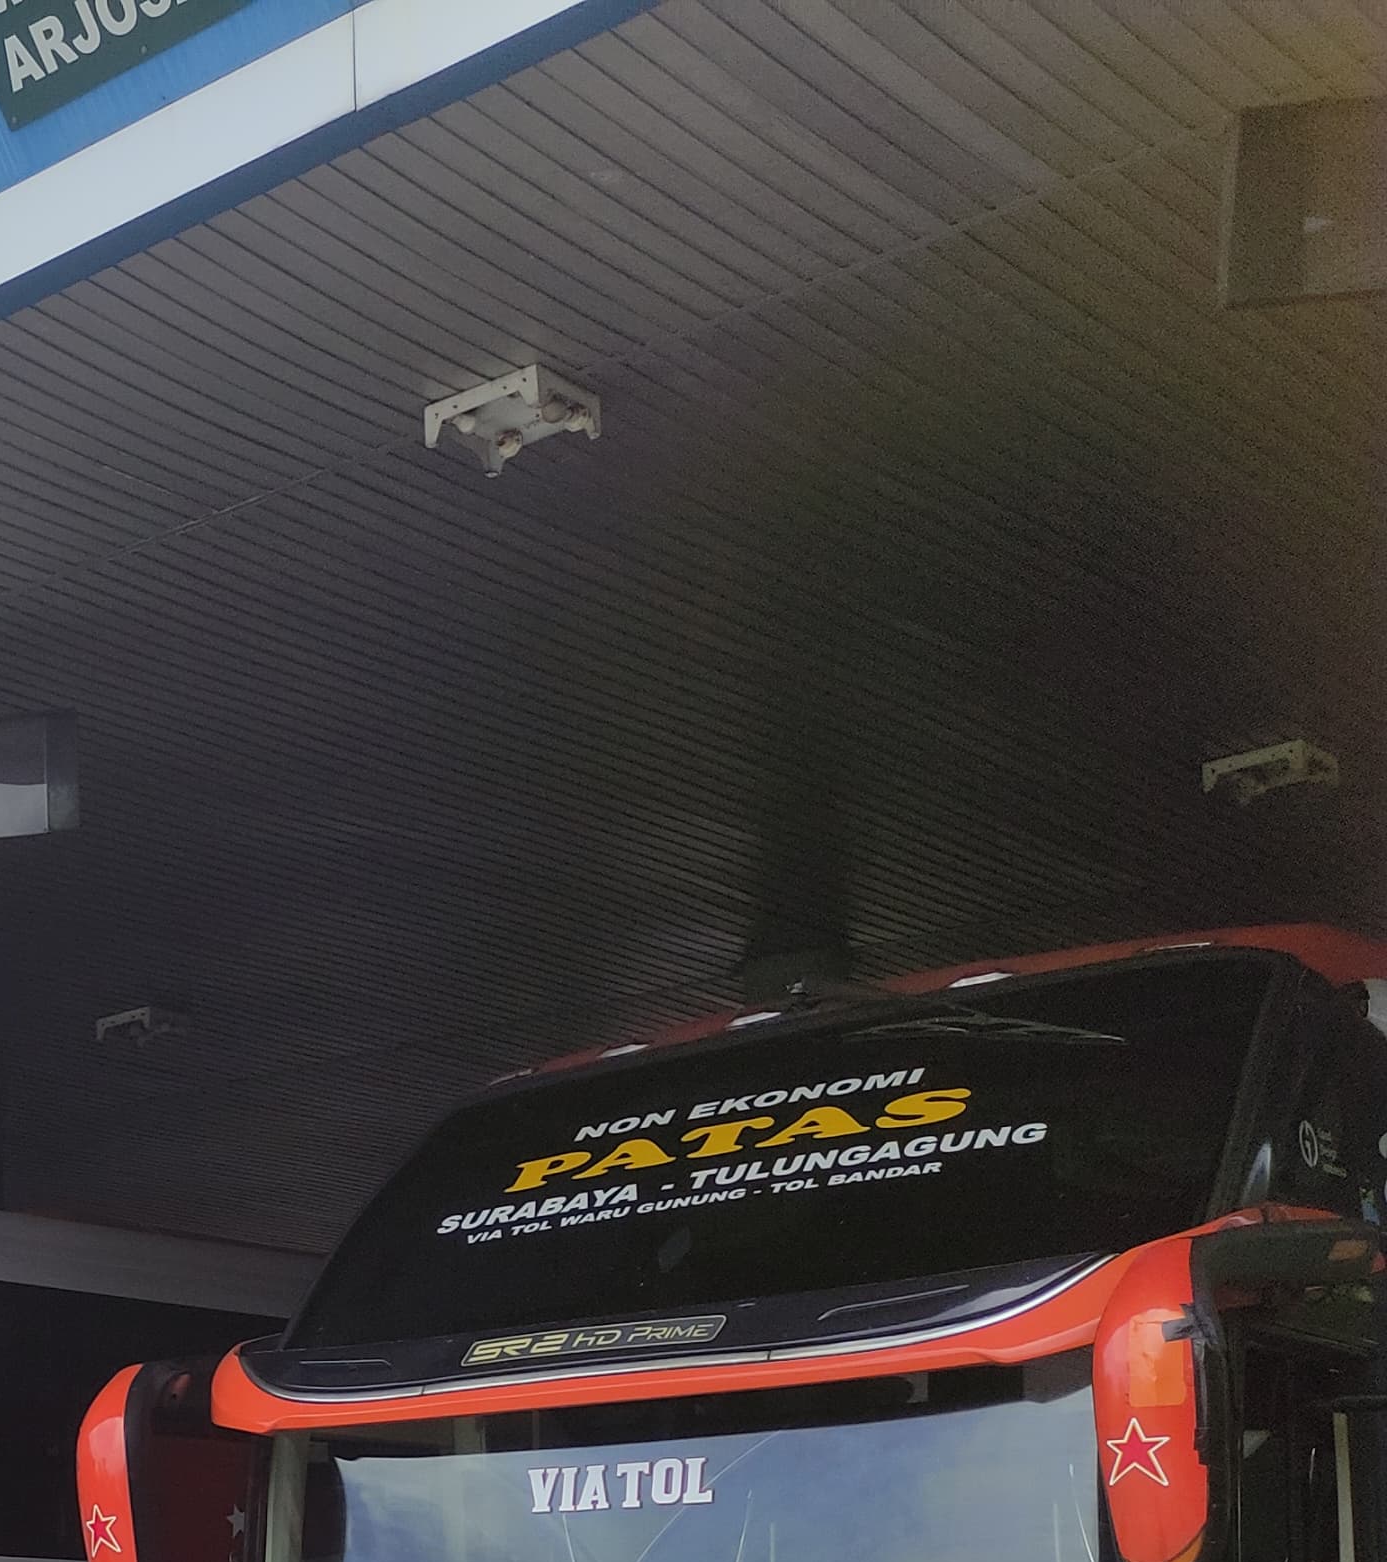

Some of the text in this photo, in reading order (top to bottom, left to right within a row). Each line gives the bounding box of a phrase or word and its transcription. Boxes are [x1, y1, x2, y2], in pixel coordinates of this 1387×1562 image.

[503, 1087, 973, 1194] PATAS
[574, 1066, 927, 1143] NON EKONOMI
[435, 1183, 639, 1236] SURABAYA
[689, 1121, 1049, 1191] TULUNGAGUNG
[465, 1226, 505, 1246] VIA
[510, 1218, 555, 1239] TOL
[558, 1205, 631, 1231] WARU
[635, 1186, 749, 1221] GUNUNG
[769, 1177, 822, 1197] TOL
[824, 1160, 943, 1190] BANDAR
[527, 1456, 715, 1515] VIA TOL
